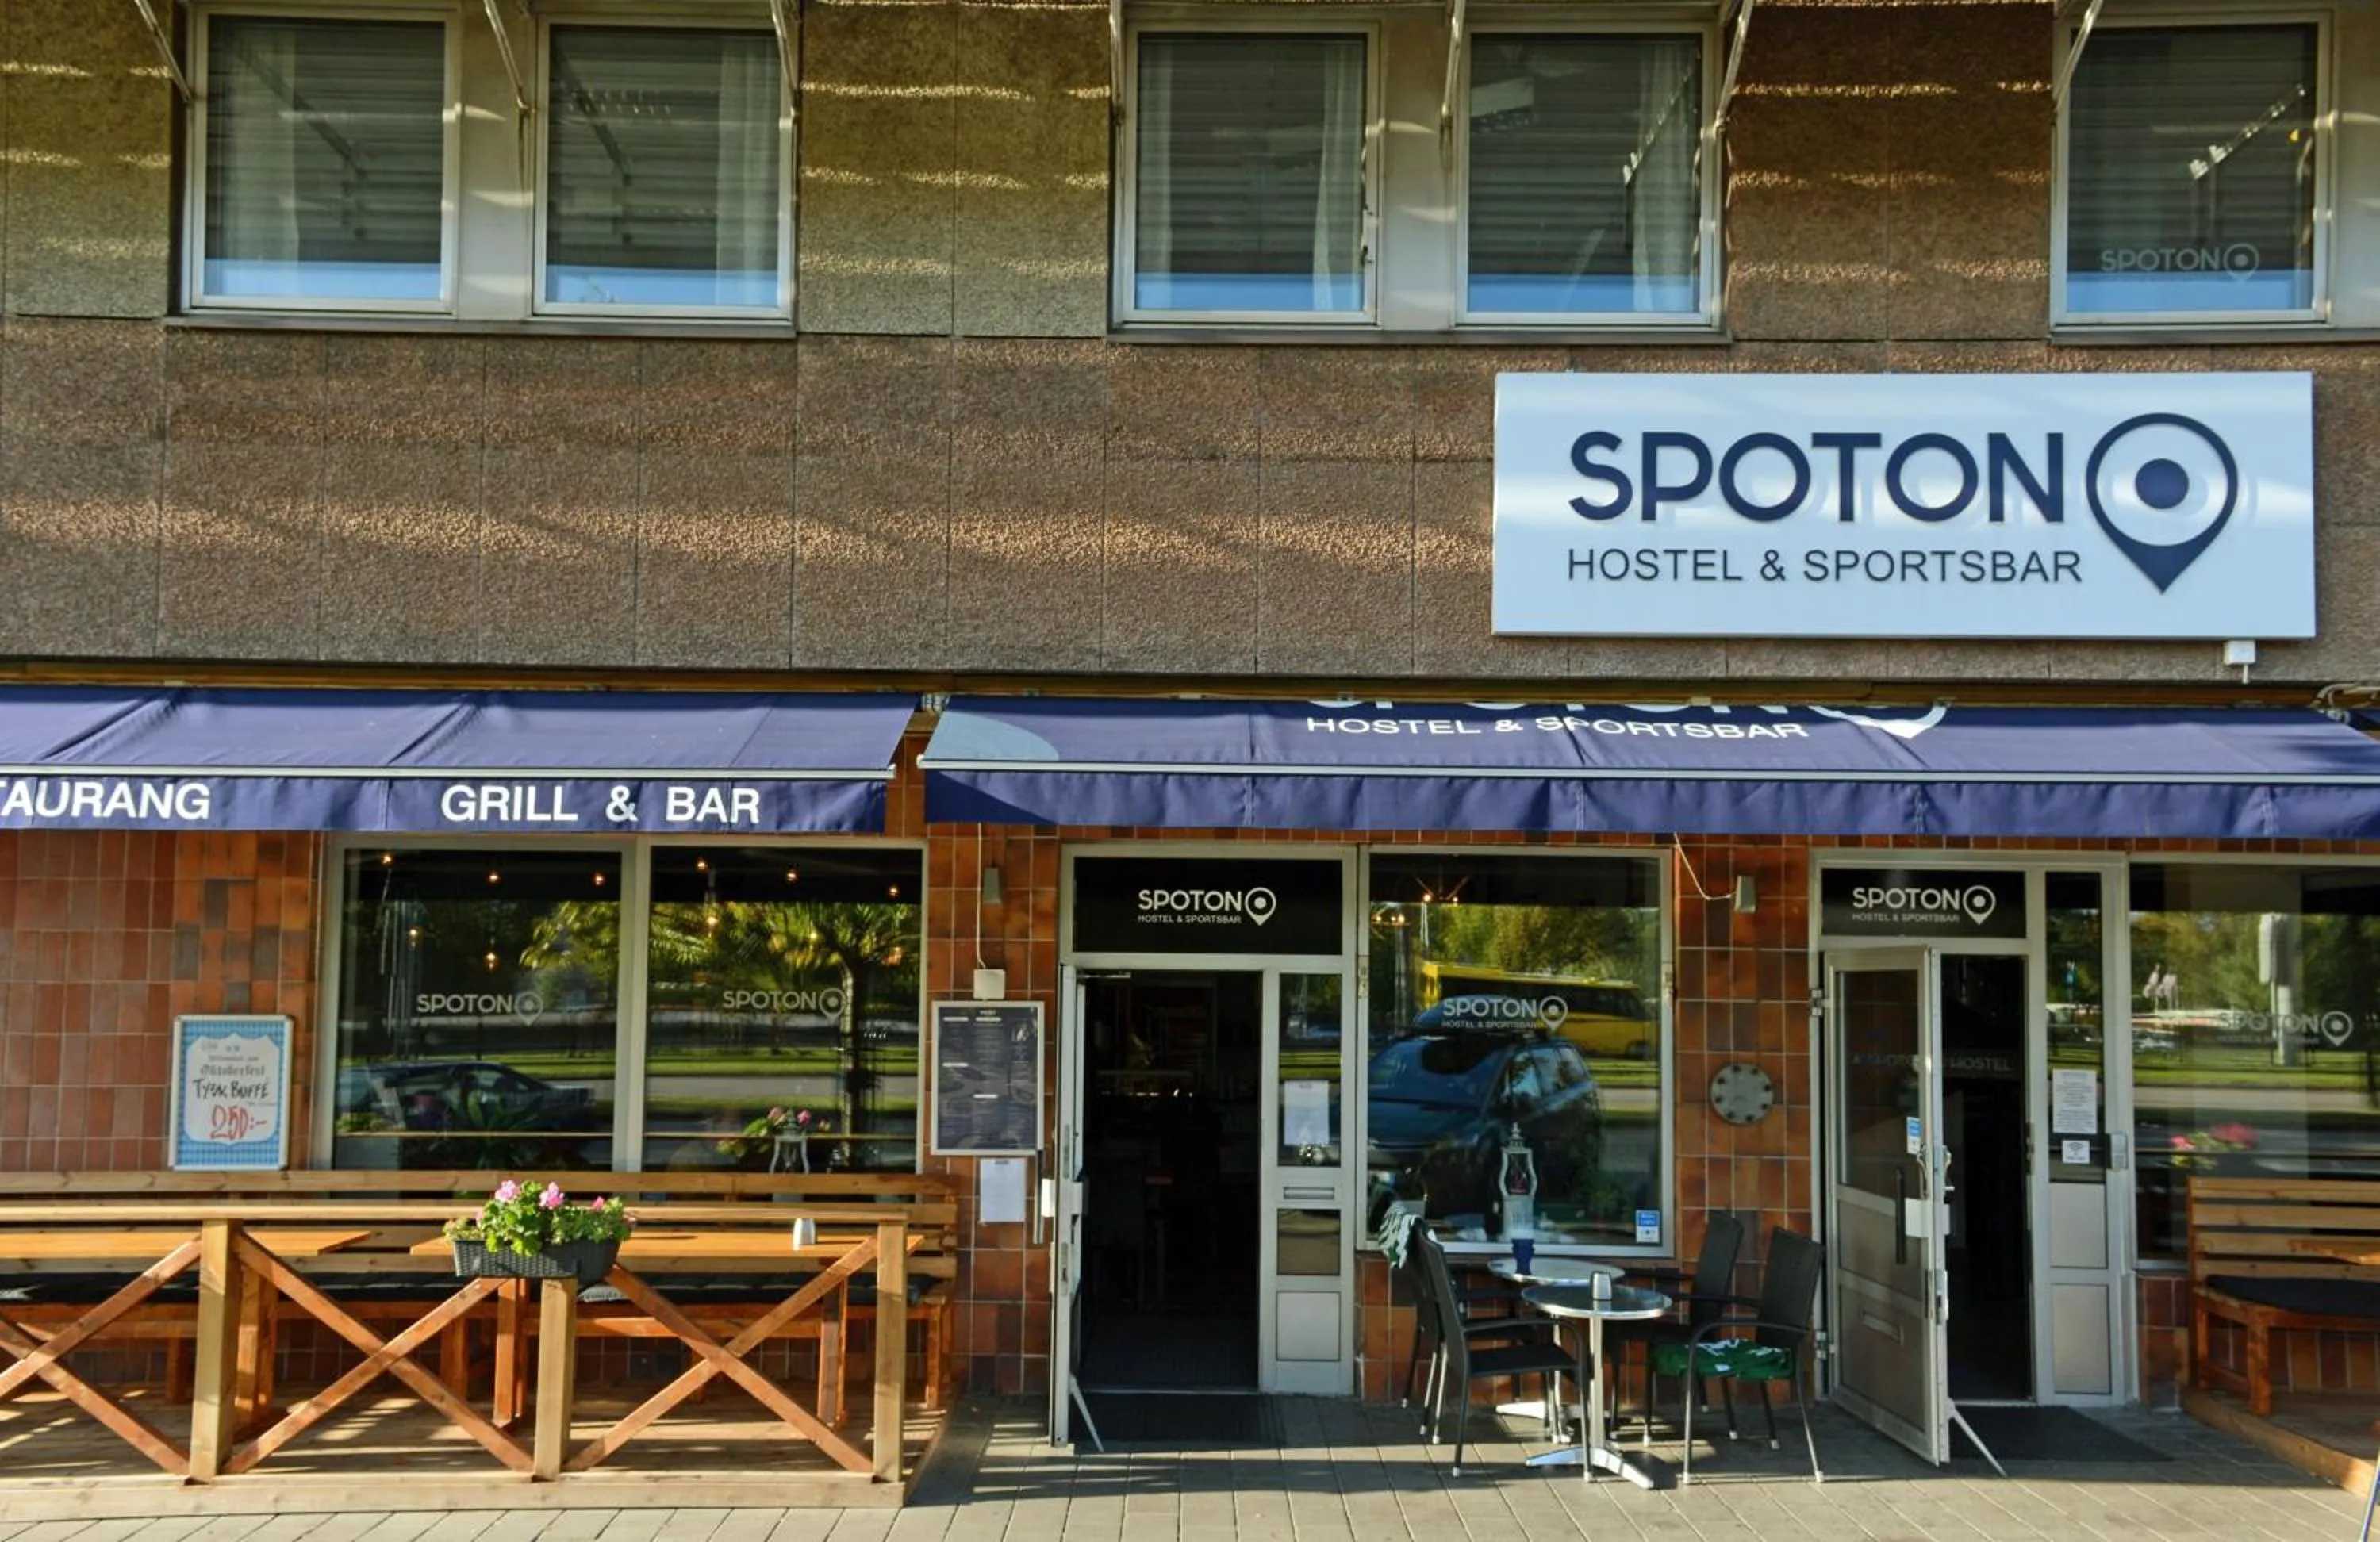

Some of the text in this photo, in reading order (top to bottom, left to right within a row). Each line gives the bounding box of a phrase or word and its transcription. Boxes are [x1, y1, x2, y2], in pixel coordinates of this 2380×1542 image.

[2101, 248, 2220, 271] SPOTON
[1568, 431, 2063, 523] SPOTON
[1568, 549, 2082, 584] HOSTEL & SPORTSBAR
[1306, 716, 1810, 738] HOSTEL & SPORTSBAR
[441, 784, 578, 823] GRILL
[605, 785, 639, 823] &
[666, 787, 760, 824] BAR
[1138, 889, 1242, 911] SPOTON
[1852, 888, 1960, 911] SPOTON
[1138, 914, 1174, 923] HOSTEL
[1185, 915, 1242, 924] SPORTSBAR
[1852, 913, 1890, 923] HOSTEL
[1902, 914, 1960, 923] SPORTSBAR
[416, 994, 512, 1014] SPOTON
[723, 990, 816, 1010] SPOTON
[1443, 999, 1537, 1018] SPOTON
